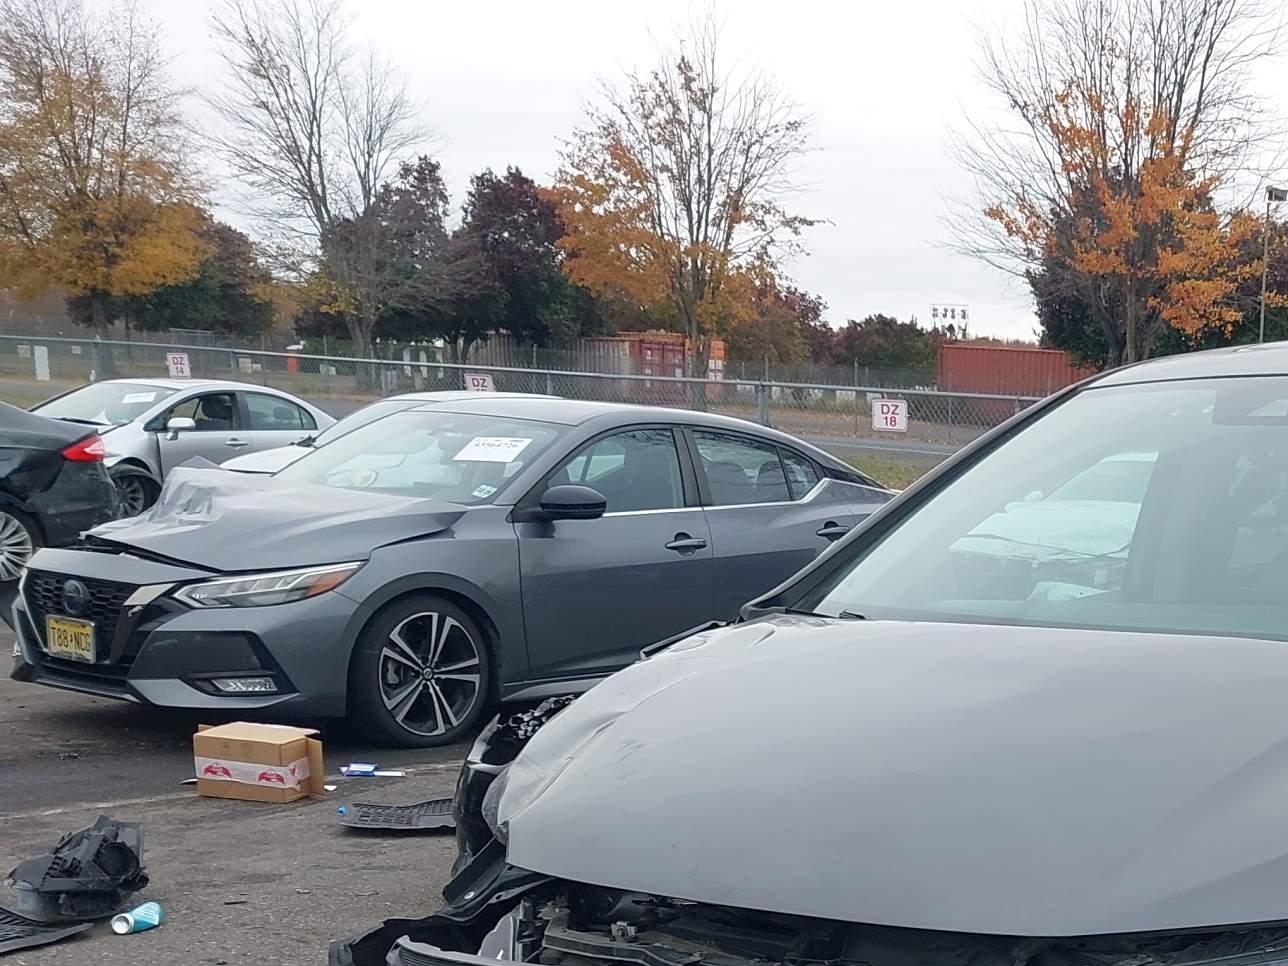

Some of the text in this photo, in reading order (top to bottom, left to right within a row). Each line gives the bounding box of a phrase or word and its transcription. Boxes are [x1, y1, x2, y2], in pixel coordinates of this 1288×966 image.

[172, 356, 185, 366] DZ
[471, 377, 488, 388] DZ
[880, 403, 900, 415] DZ
[883, 415, 897, 427] 18
